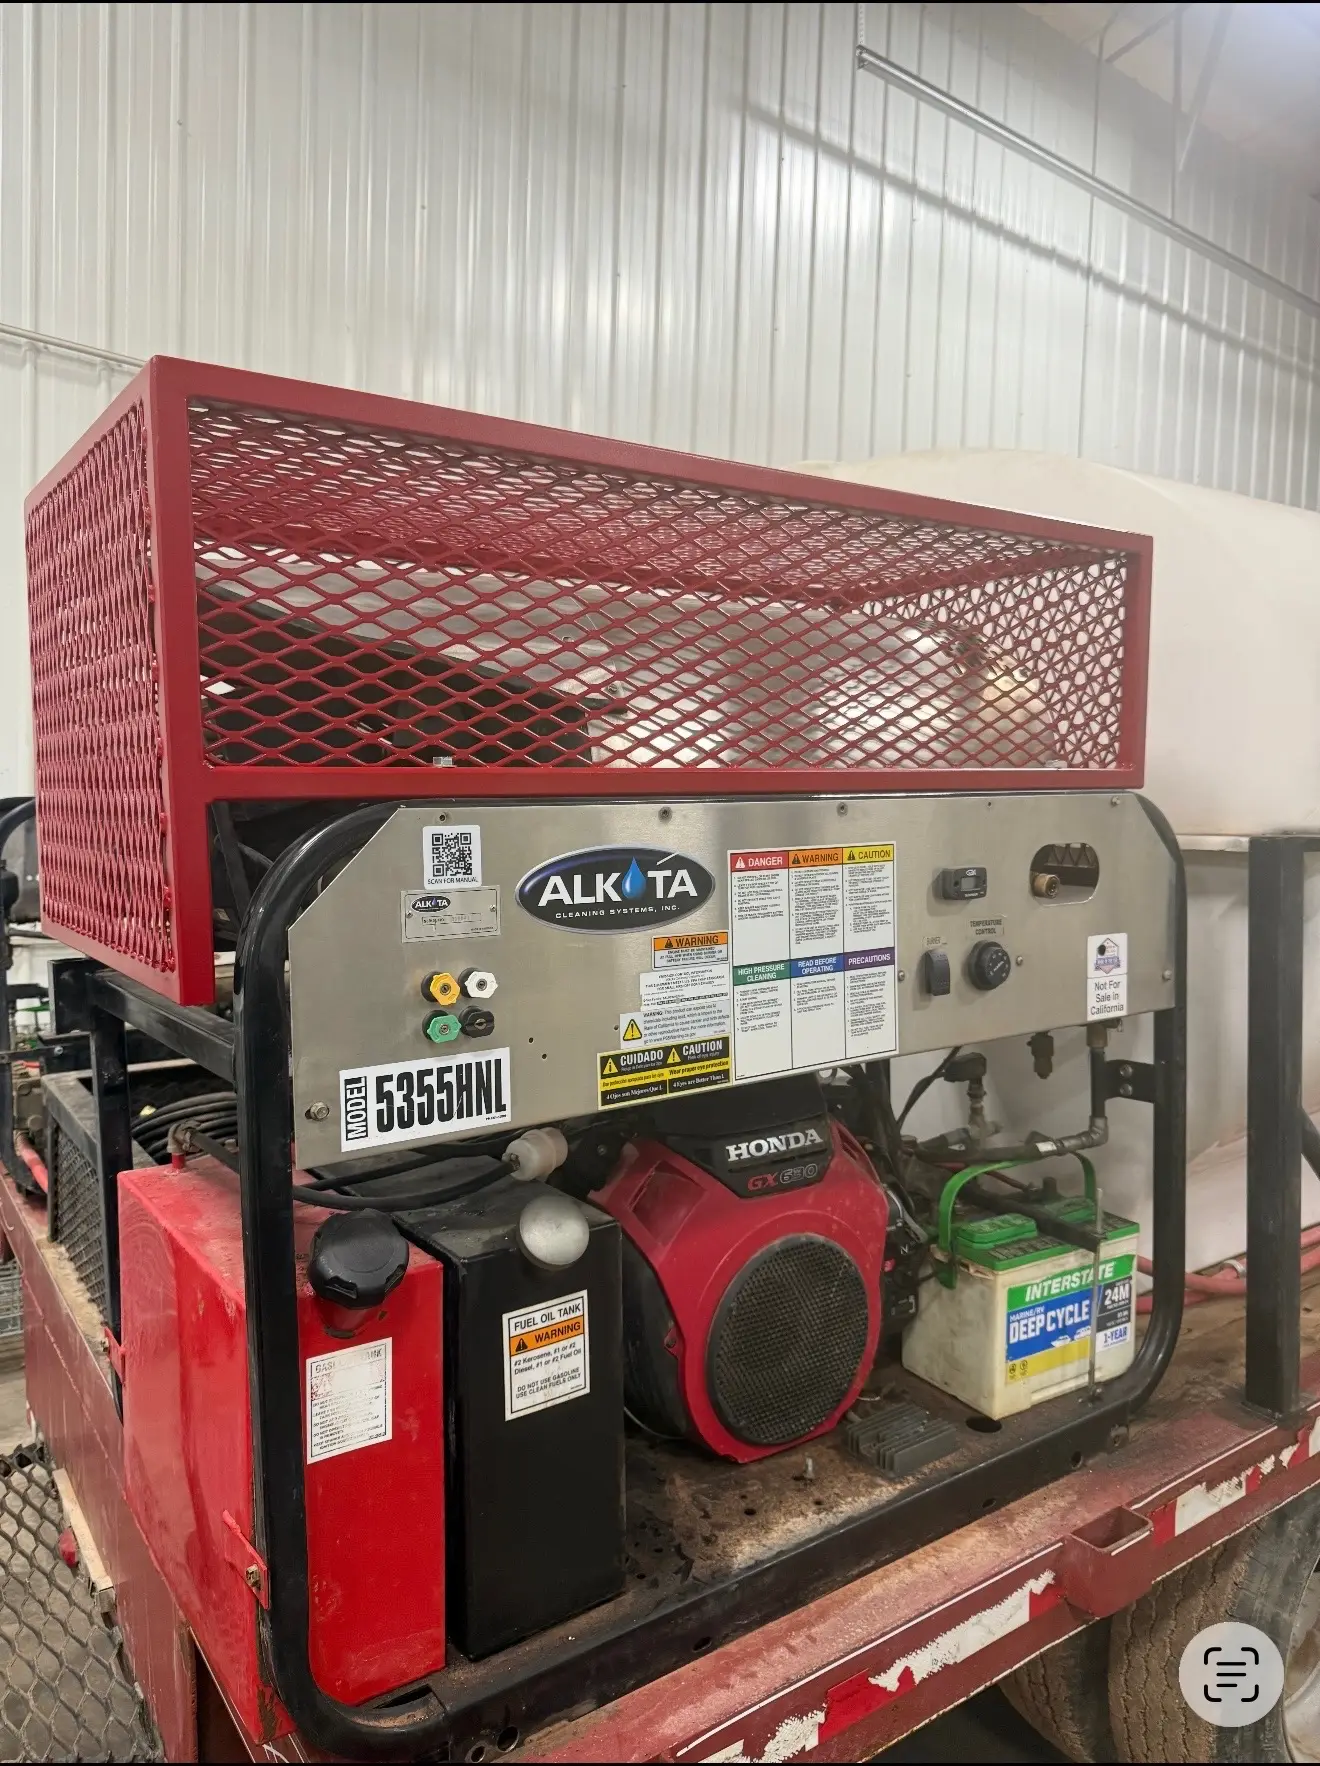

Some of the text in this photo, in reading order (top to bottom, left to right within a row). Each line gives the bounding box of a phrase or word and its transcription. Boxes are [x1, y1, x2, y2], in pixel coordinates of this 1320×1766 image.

[748, 856, 783, 867] DANGER
[802, 852, 839, 863] WARNING
[858, 849, 891, 860] CAUTION
[555, 909, 605, 919] CLEANING
[609, 906, 657, 915] SYSTEMS,
[970, 919, 1002, 928] TEMPERATURE
[675, 935, 719, 947] WARNING
[798, 956, 836, 968] READ BEFORE
[848, 953, 891, 965] PRECAUTIONS
[738, 963, 785, 976] HIGH PRESSURE
[747, 972, 777, 982] CLEANING
[802, 965, 833, 975] OPERATING
[1094, 980, 1120, 991] Not For
[1095, 991, 1119, 1003] Sale in
[1090, 1003, 1124, 1015] California
[682, 1039, 723, 1056] CAUTION
[620, 1049, 664, 1066] CUIDADO
[669, 1067, 681, 1075] Wear
[682, 1065, 696, 1074] proper
[706, 1060, 729, 1070] protection
[677, 1080, 687, 1088] Eyes
[695, 1076, 709, 1084] Better
[375, 1058, 507, 1133] 5355HNL
[346, 1077, 367, 1140] MODEL
[725, 1128, 824, 1162] HONDA
[1025, 1262, 1116, 1303] INTERSTATE
[1104, 1283, 1130, 1306] 24M
[514, 1302, 581, 1332] FUEL OIL TANK
[1009, 1305, 1045, 1322] MARINE/RV
[1009, 1299, 1090, 1344] DEEP CYCLE
[534, 1321, 581, 1343] WARNING
[1103, 1326, 1128, 1344] 1-YEAR
[514, 1359, 521, 1367] #2
[523, 1350, 552, 1364] Kerosene,
[569, 1342, 576, 1350] #2
[514, 1364, 535, 1375] Diesel,
[536, 1361, 543, 1369] #1
[560, 1350, 573, 1361] Fuel
[574, 1347, 582, 1356] Oil
[515, 1389, 527, 1399] USE
[529, 1383, 548, 1396] CLEAN
[548, 1377, 567, 1389] FUELS
[567, 1372, 582, 1383] ONLY
[517, 1366, 580, 1393] DO NOT USE GASOLINE
